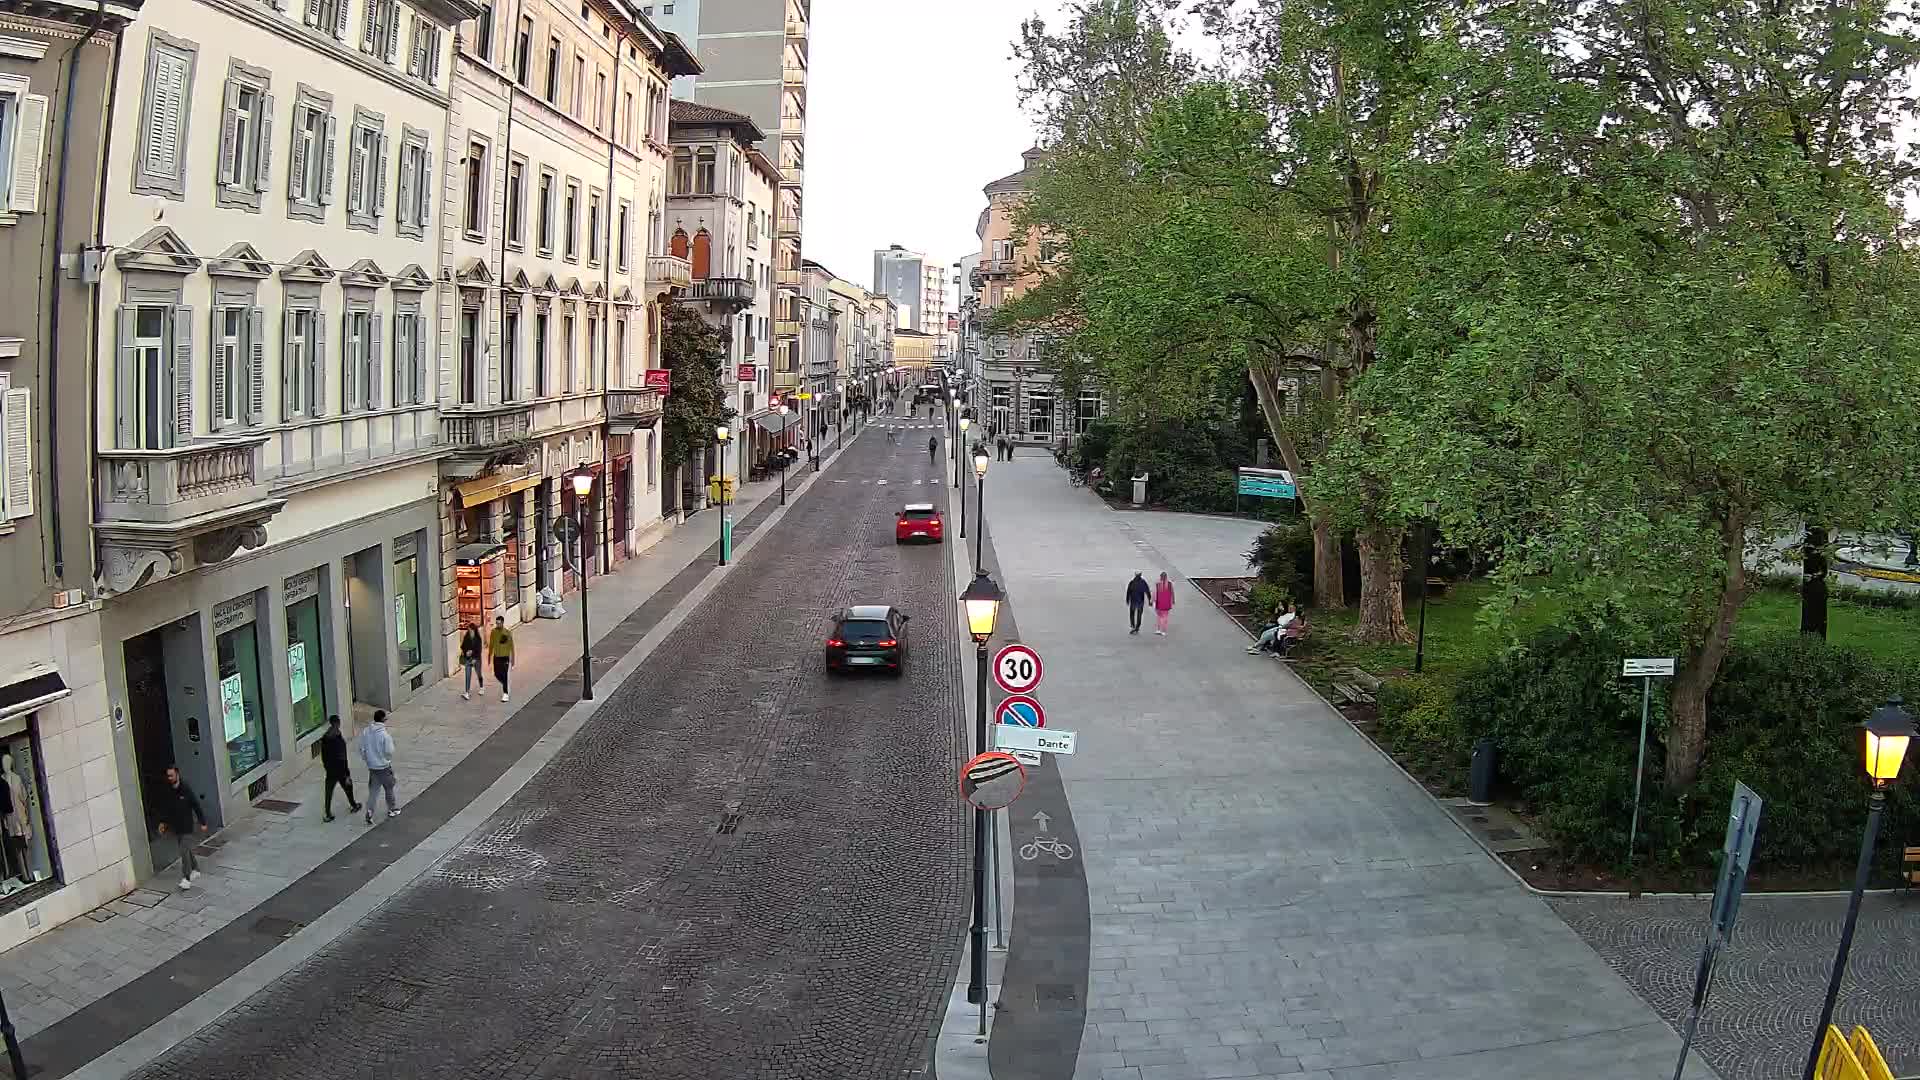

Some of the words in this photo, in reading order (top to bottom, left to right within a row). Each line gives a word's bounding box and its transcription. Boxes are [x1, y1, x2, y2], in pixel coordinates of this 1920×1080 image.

[1005, 658, 1032, 680] 30
[222, 678, 240, 700] 130
[1038, 738, 1069, 749] Dante
